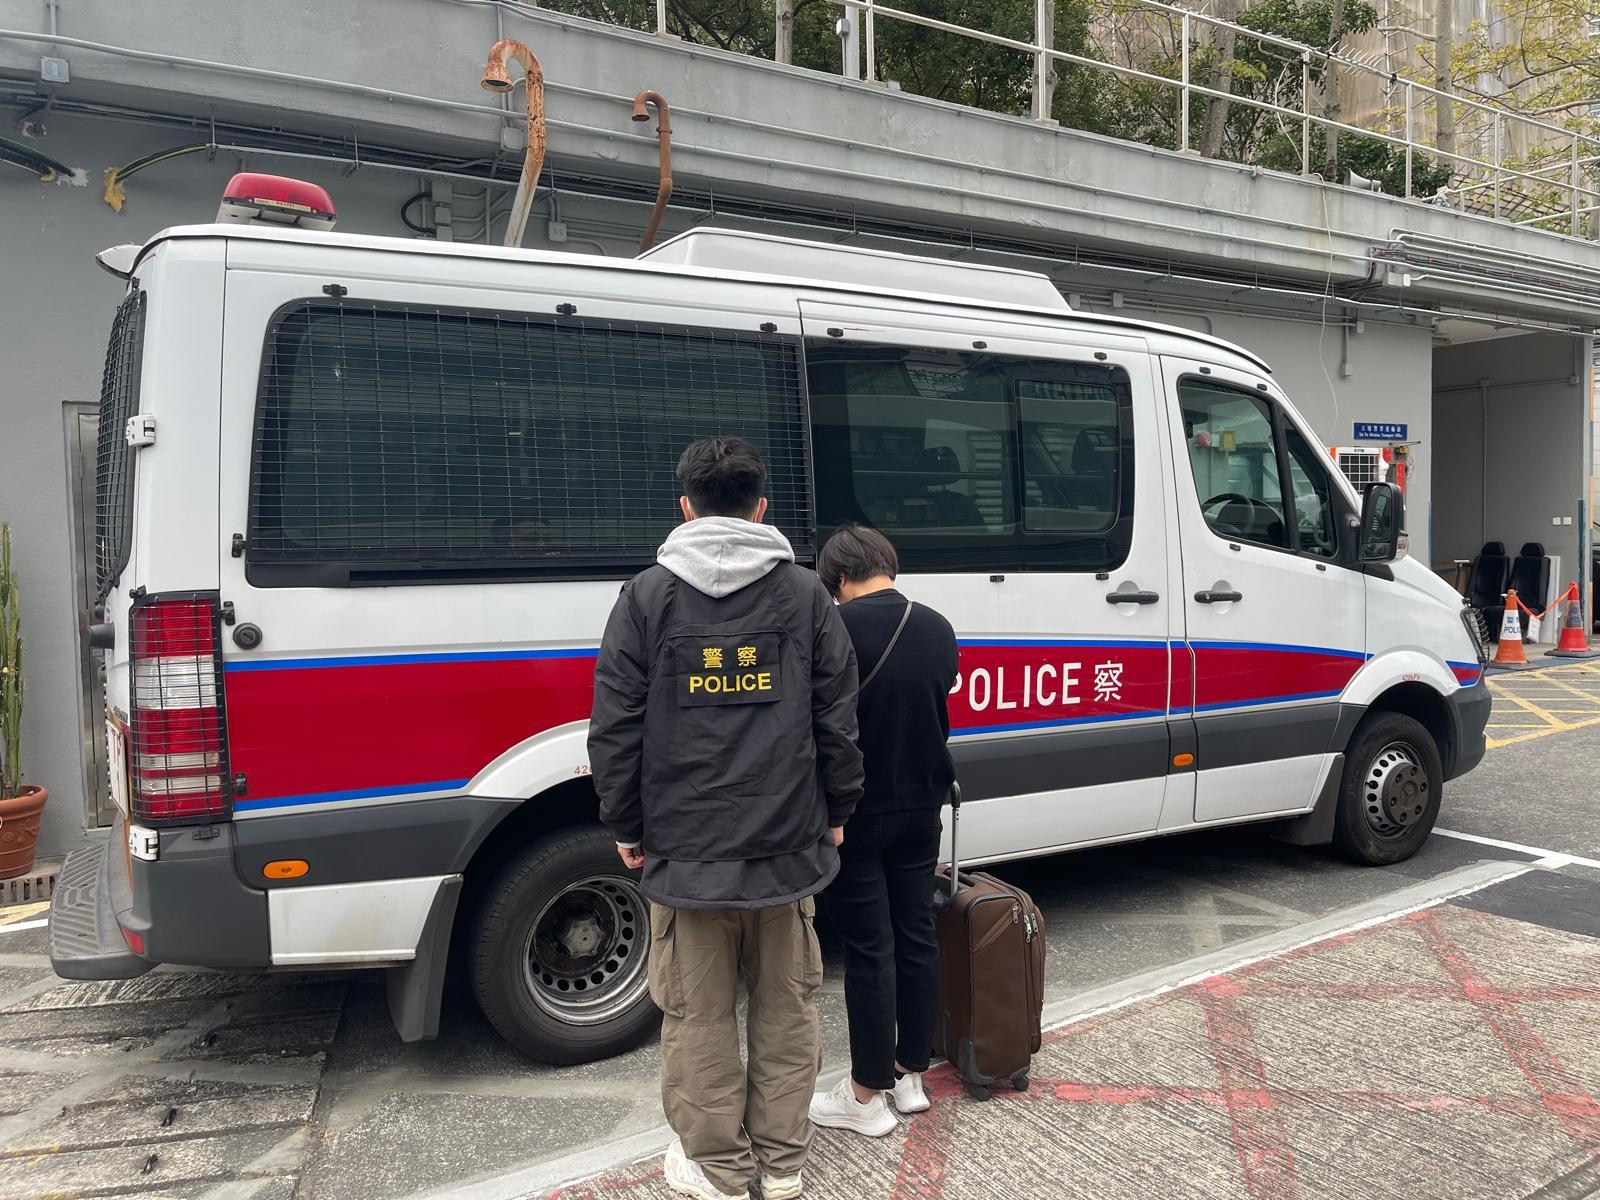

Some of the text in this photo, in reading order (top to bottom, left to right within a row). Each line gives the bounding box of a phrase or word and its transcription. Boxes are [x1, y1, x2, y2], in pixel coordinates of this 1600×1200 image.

[703, 646, 757, 669] 警察
[689, 672, 772, 694] POLICE
[1094, 660, 1123, 702] 察
